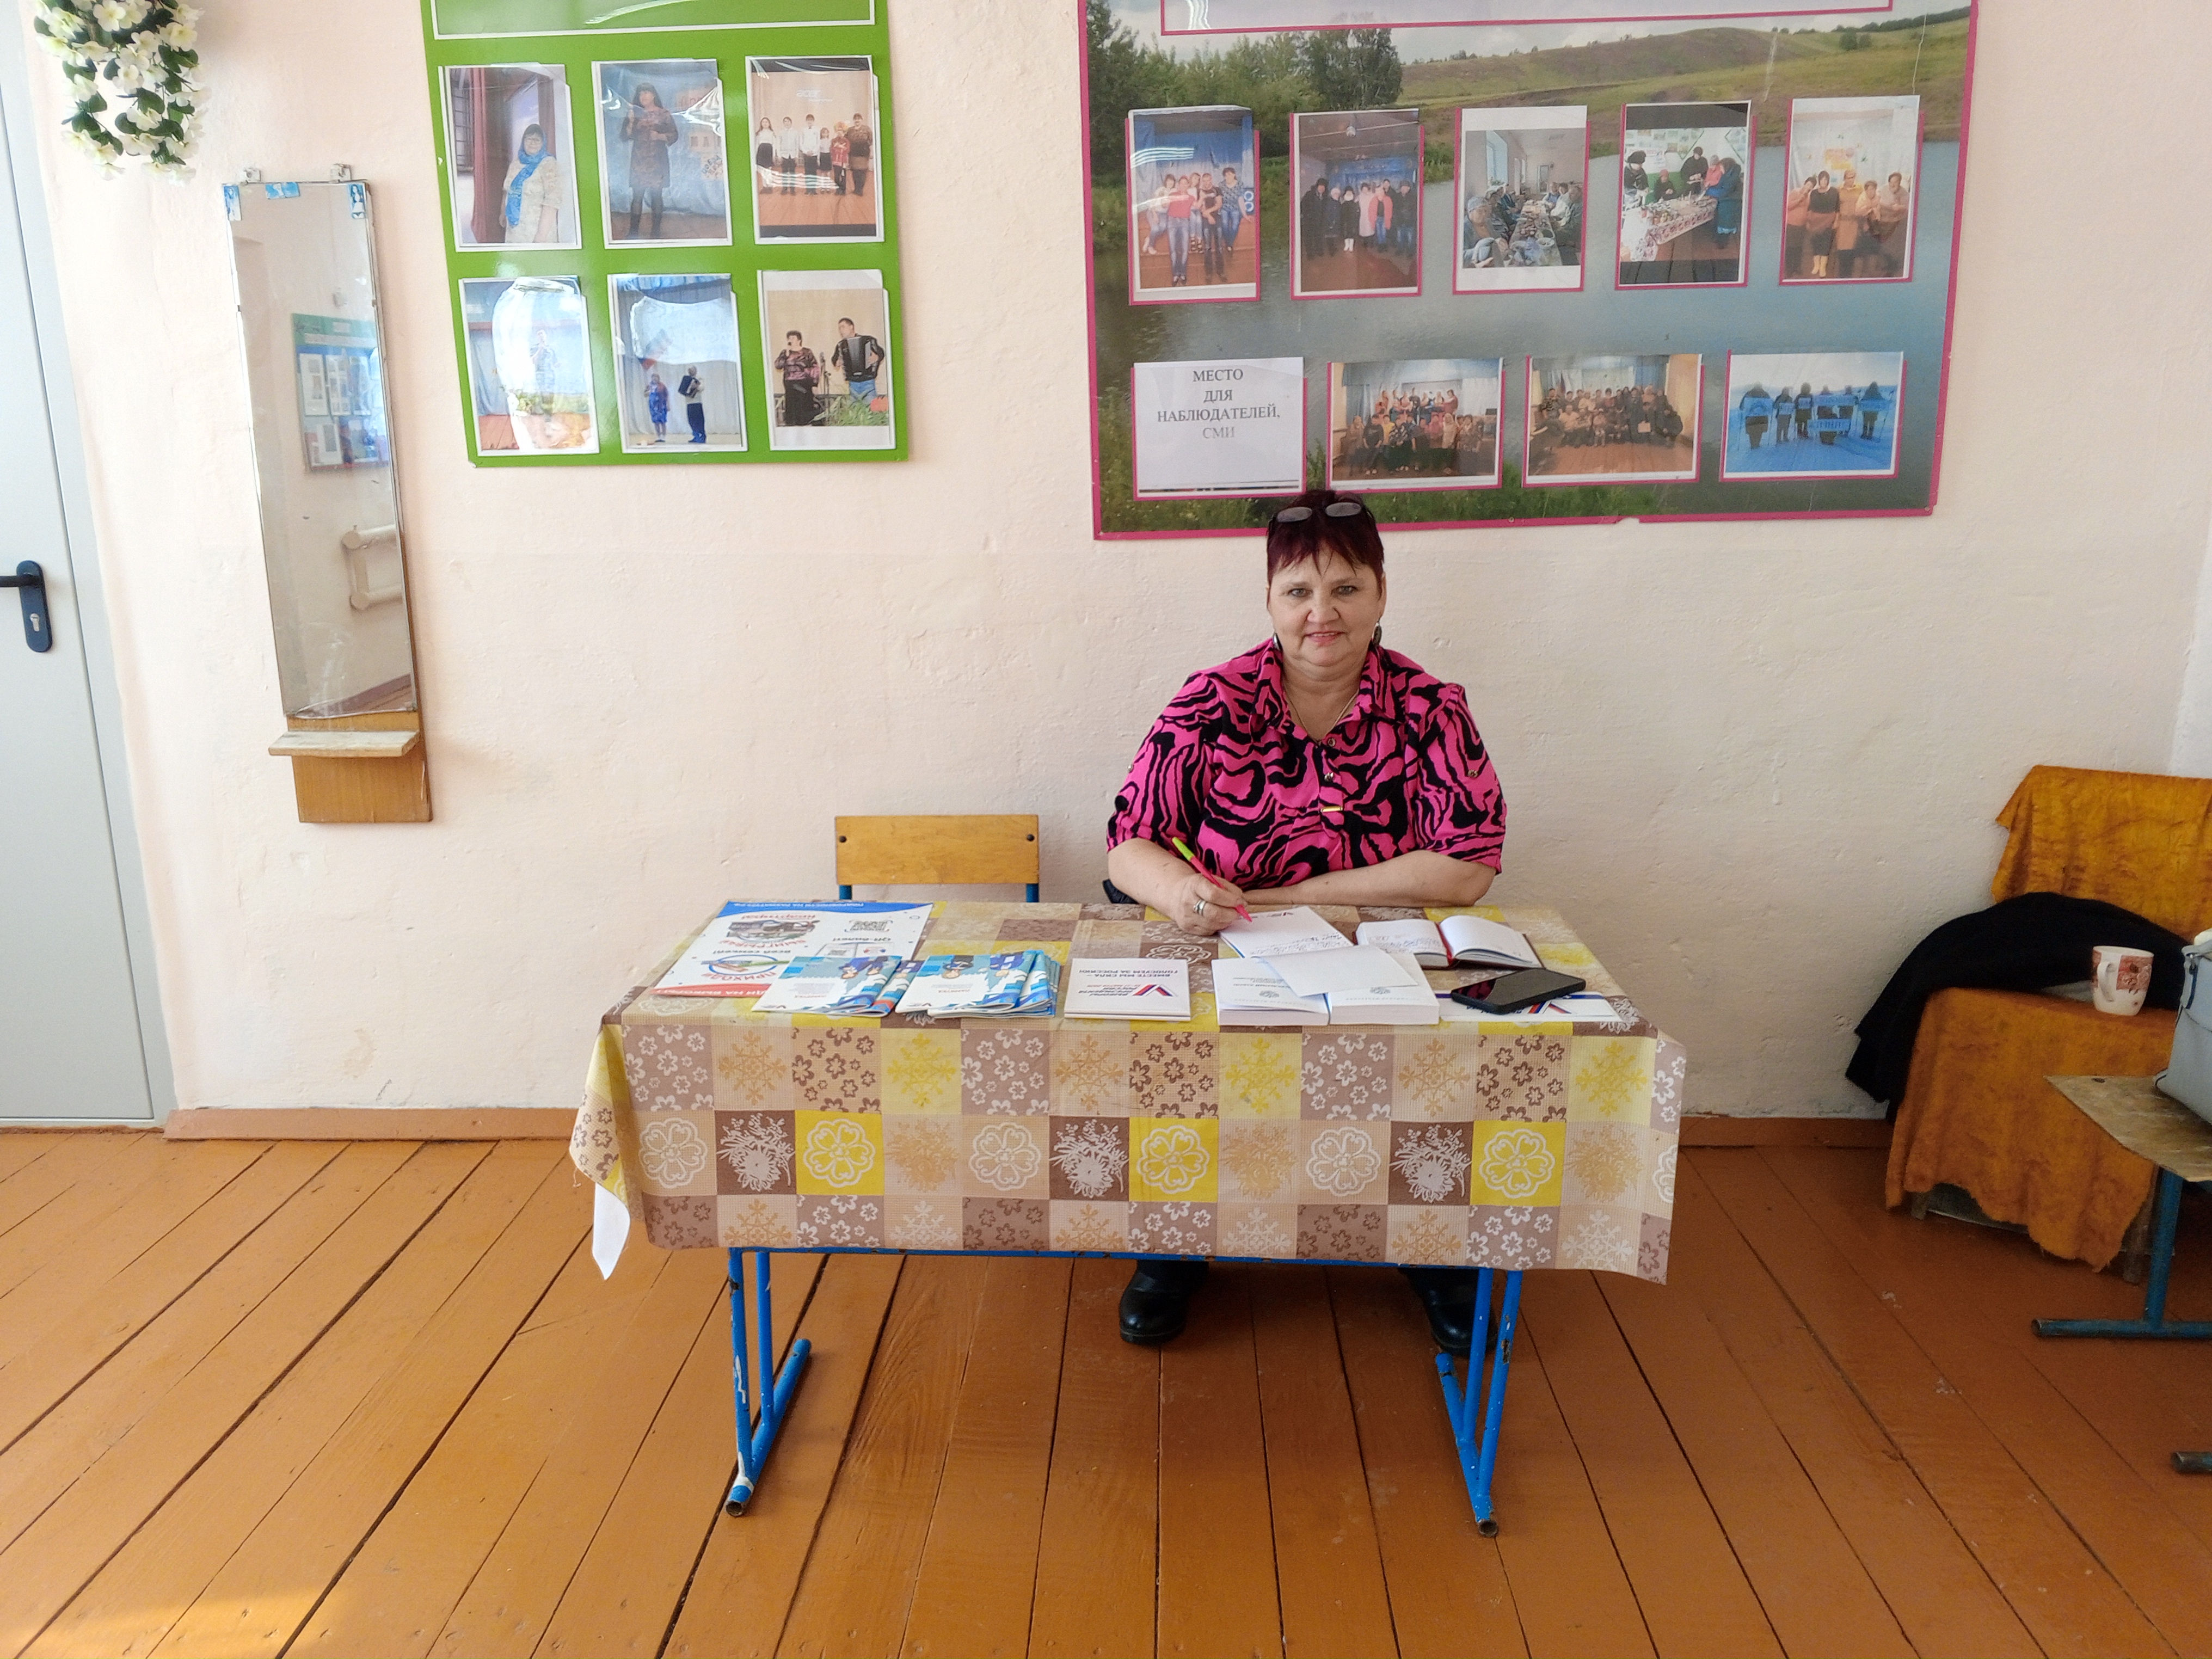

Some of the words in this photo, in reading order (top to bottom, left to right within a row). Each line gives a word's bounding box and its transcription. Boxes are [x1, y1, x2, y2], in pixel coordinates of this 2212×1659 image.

[1193, 369, 1244, 382] МЕСТО
[1203, 389, 1233, 403] ДЛЯ
[1157, 403, 1281, 423] НАБЛЮДАТЕЛЕЙ,
[1202, 426, 1234, 439] СМИ
